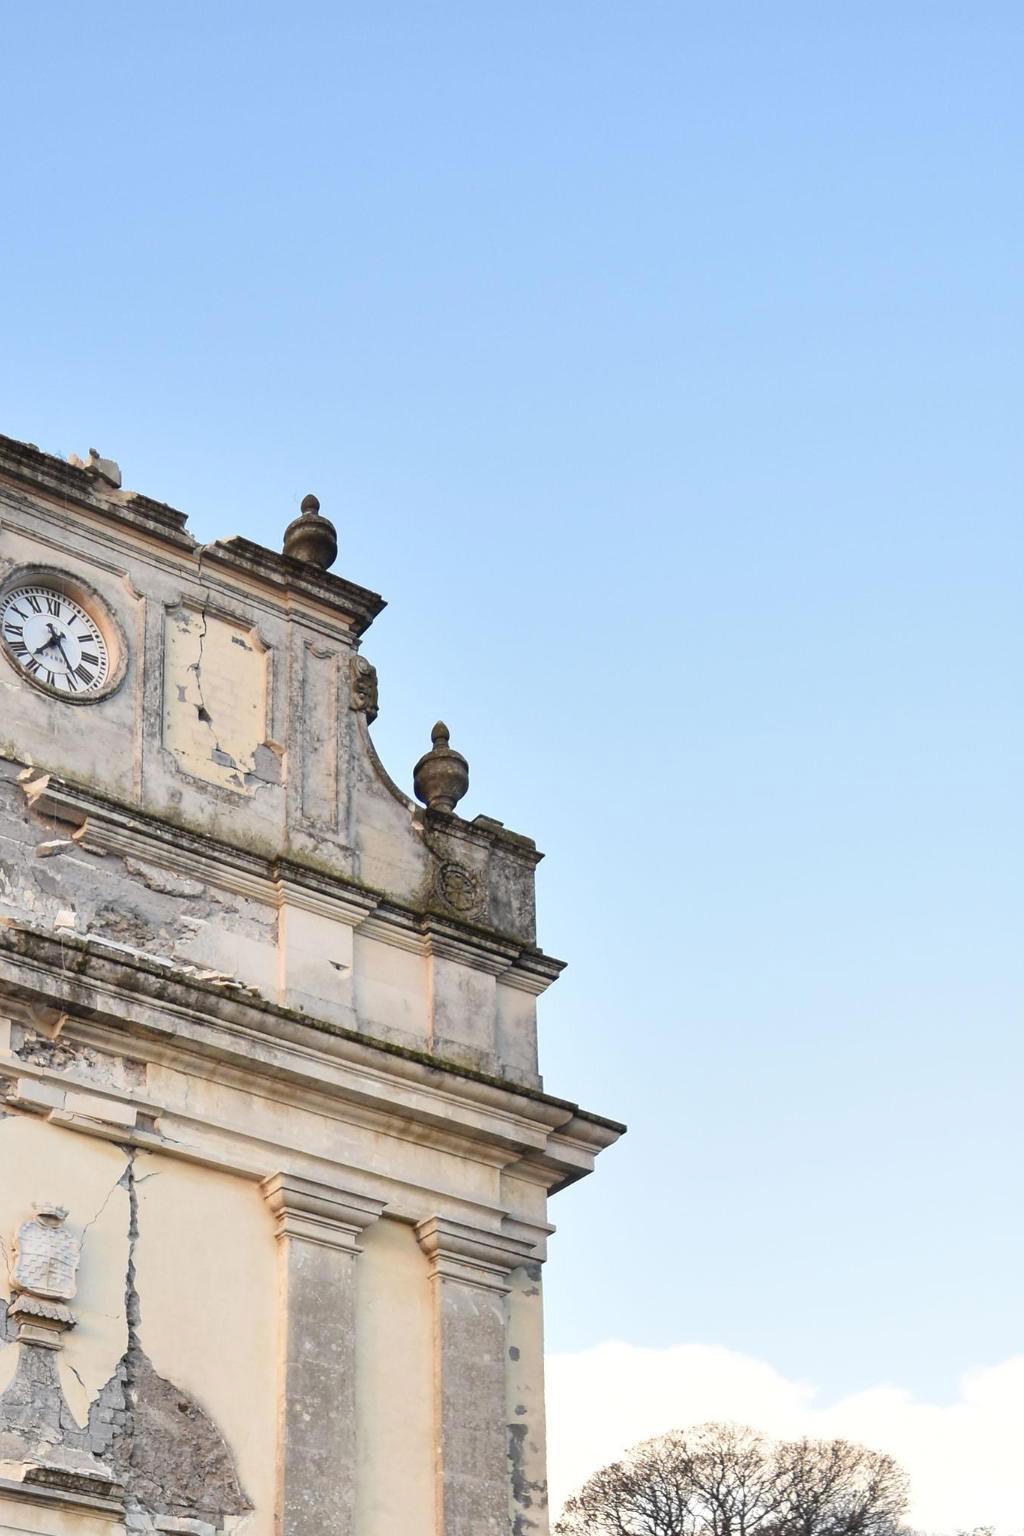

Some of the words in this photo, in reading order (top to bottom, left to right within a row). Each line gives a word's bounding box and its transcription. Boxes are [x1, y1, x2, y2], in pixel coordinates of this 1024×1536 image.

[10, 603, 29, 622] X
[46, 597, 61, 617] XII
[77, 634, 94, 642] II
[81, 651, 99, 666] III
